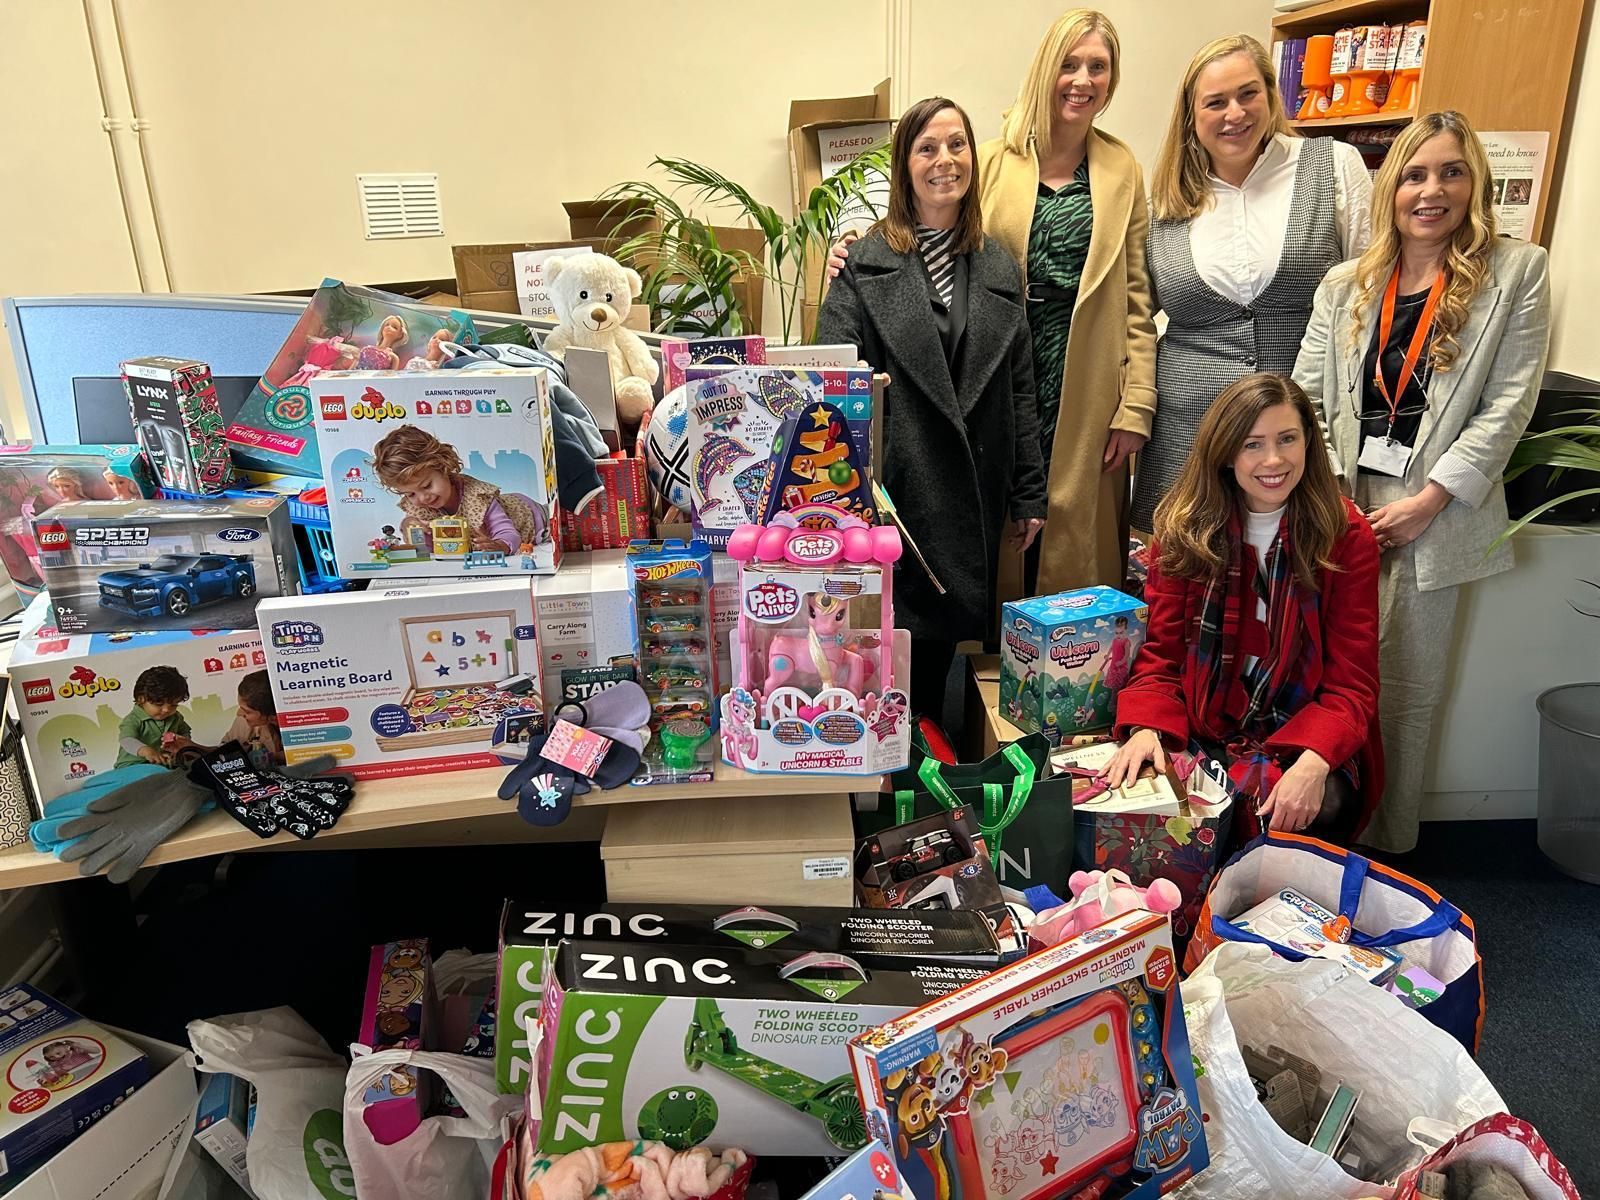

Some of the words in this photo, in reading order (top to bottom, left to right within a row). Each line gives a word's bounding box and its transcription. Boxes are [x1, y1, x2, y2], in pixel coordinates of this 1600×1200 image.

[829, 138, 860, 149] PLEASE
[861, 137, 873, 145] DO
[830, 153, 851, 163] NOT
[1487, 148, 1506, 158] need
[1507, 149, 1515, 158] to
[1516, 147, 1539, 158] know
[524, 265, 542, 274] PLE
[531, 307, 555, 316] RESE
[824, 379, 842, 387] 5-10
[136, 384, 169, 400] LYNX
[703, 386, 718, 400] OUT
[718, 384, 728, 395] TO
[323, 403, 343, 413] LEGO
[351, 401, 407, 423] duplo
[696, 396, 743, 421] IMPRESS
[229, 425, 263, 444] Fantasy
[265, 434, 299, 450] Friends
[618, 501, 626, 512] HO
[601, 514, 609, 534] SNOW
[619, 514, 627, 523] HO
[75, 527, 149, 541] SPEED
[225, 530, 253, 542] Ford
[620, 525, 628, 537] HO
[41, 532, 66, 544] LEGO
[103, 538, 148, 546] CHAMPIONS
[794, 539, 832, 550] Pets
[799, 545, 832, 555] Alive
[648, 565, 667, 580] HOT
[665, 560, 699, 577] WHEELS
[748, 587, 797, 608] Pets
[57, 607, 74, 616] 9+
[540, 601, 564, 610] Little
[567, 600, 590, 608] Town
[757, 603, 796, 618] Alive
[713, 610, 727, 618] arry
[275, 622, 314, 637] Time
[546, 623, 567, 631] Carry
[567, 622, 587, 630] Along
[277, 634, 321, 644] LEARN
[452, 632, 466, 647] b
[1005, 631, 1040, 659] Unicorn
[1051, 640, 1100, 660] Unicorn
[276, 656, 349, 674] Magnetic
[279, 675, 346, 691] Learning
[348, 669, 393, 684] Board
[565, 675, 588, 683] GLOW
[26, 685, 50, 698] LEGO
[59, 676, 121, 699] duplo
[565, 680, 617, 699] STA
[796, 752, 811, 760] MY
[811, 749, 846, 759] MAGICAL
[781, 760, 822, 770] UNICORN
[829, 756, 863, 767] STABLE
[953, 811, 965, 821] 6+
[1000, 848, 1031, 881] N
[841, 922, 885, 931] FOLDING
[886, 923, 934, 932] SCOOTER
[848, 917, 872, 925] TWO
[873, 917, 922, 926] WHEELED
[850, 931, 887, 939] UNICORN
[888, 931, 930, 939] EXPLORER
[850, 937, 891, 945] DINOSAUR
[892, 937, 934, 946] EXPLORER
[1090, 939, 1146, 974] MAGNETIC
[910, 970, 954, 980] FOLDING
[955, 972, 987, 981] SCOO
[916, 965, 940, 973] TWO
[941, 967, 991, 977] WHEELED
[1098, 957, 1135, 984] Rainbow
[1157, 970, 1167, 980] 3
[921, 980, 960, 990] UNICORN
[957, 968, 1018, 1001] SKETCHER
[1030, 966, 1089, 1001] SKETCHER
[1411, 988, 1433, 1004] RAD
[758, 1008, 790, 1020] TWO
[794, 1009, 858, 1021] WHEELED
[919, 998, 956, 1020] TABLE
[993, 996, 1030, 1020] TABLE
[754, 1020, 818, 1032] FOLDING
[751, 1032, 818, 1045] DINOSAUR
[819, 1034, 851, 1046] EXPL
[884, 1047, 922, 1070] WARNING:
[1150, 1099, 1182, 1125] PATROL
[1136, 1110, 1202, 1168] PAW
[875, 1162, 890, 1180] 3+
